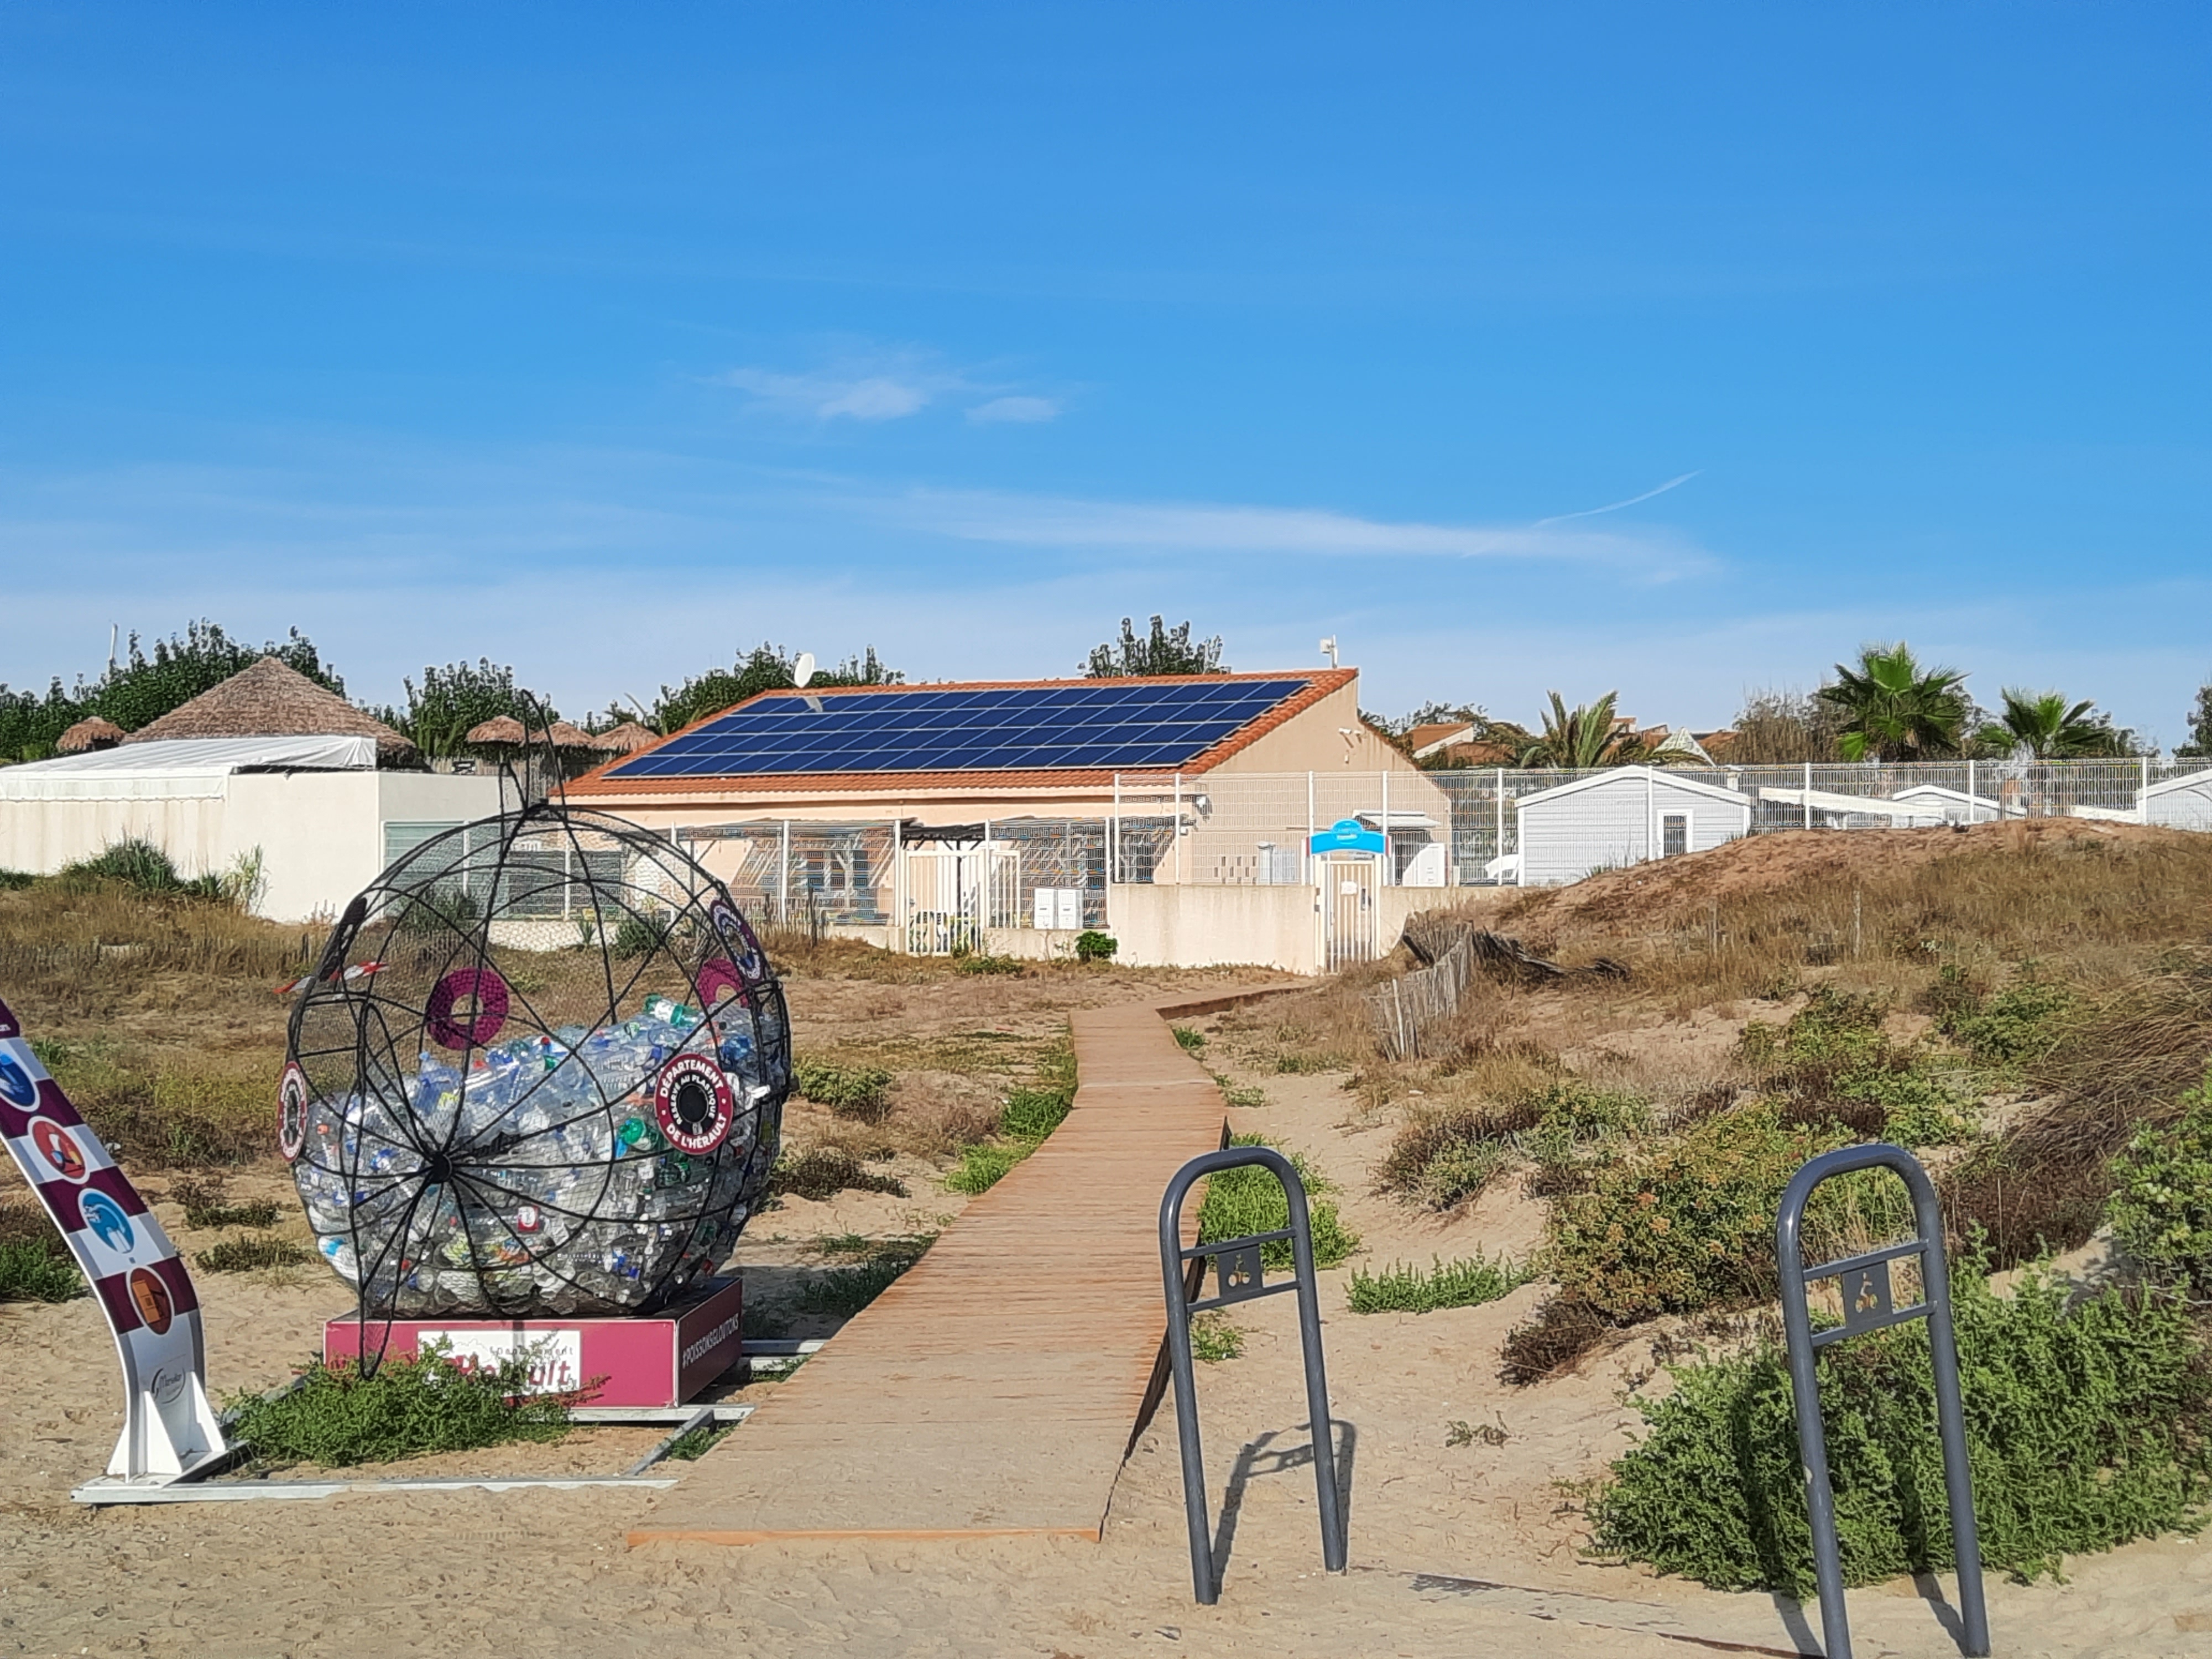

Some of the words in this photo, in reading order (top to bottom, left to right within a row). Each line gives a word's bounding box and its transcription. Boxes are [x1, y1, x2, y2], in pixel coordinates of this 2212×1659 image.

[660, 1059, 724, 1098] DÉPARTEMENT
[681, 1074, 691, 1085] AU
[691, 1074, 716, 1119] PLASTIQUE
[666, 1123, 681, 1142] DE
[681, 1112, 727, 1149] L'HÉRAULT
